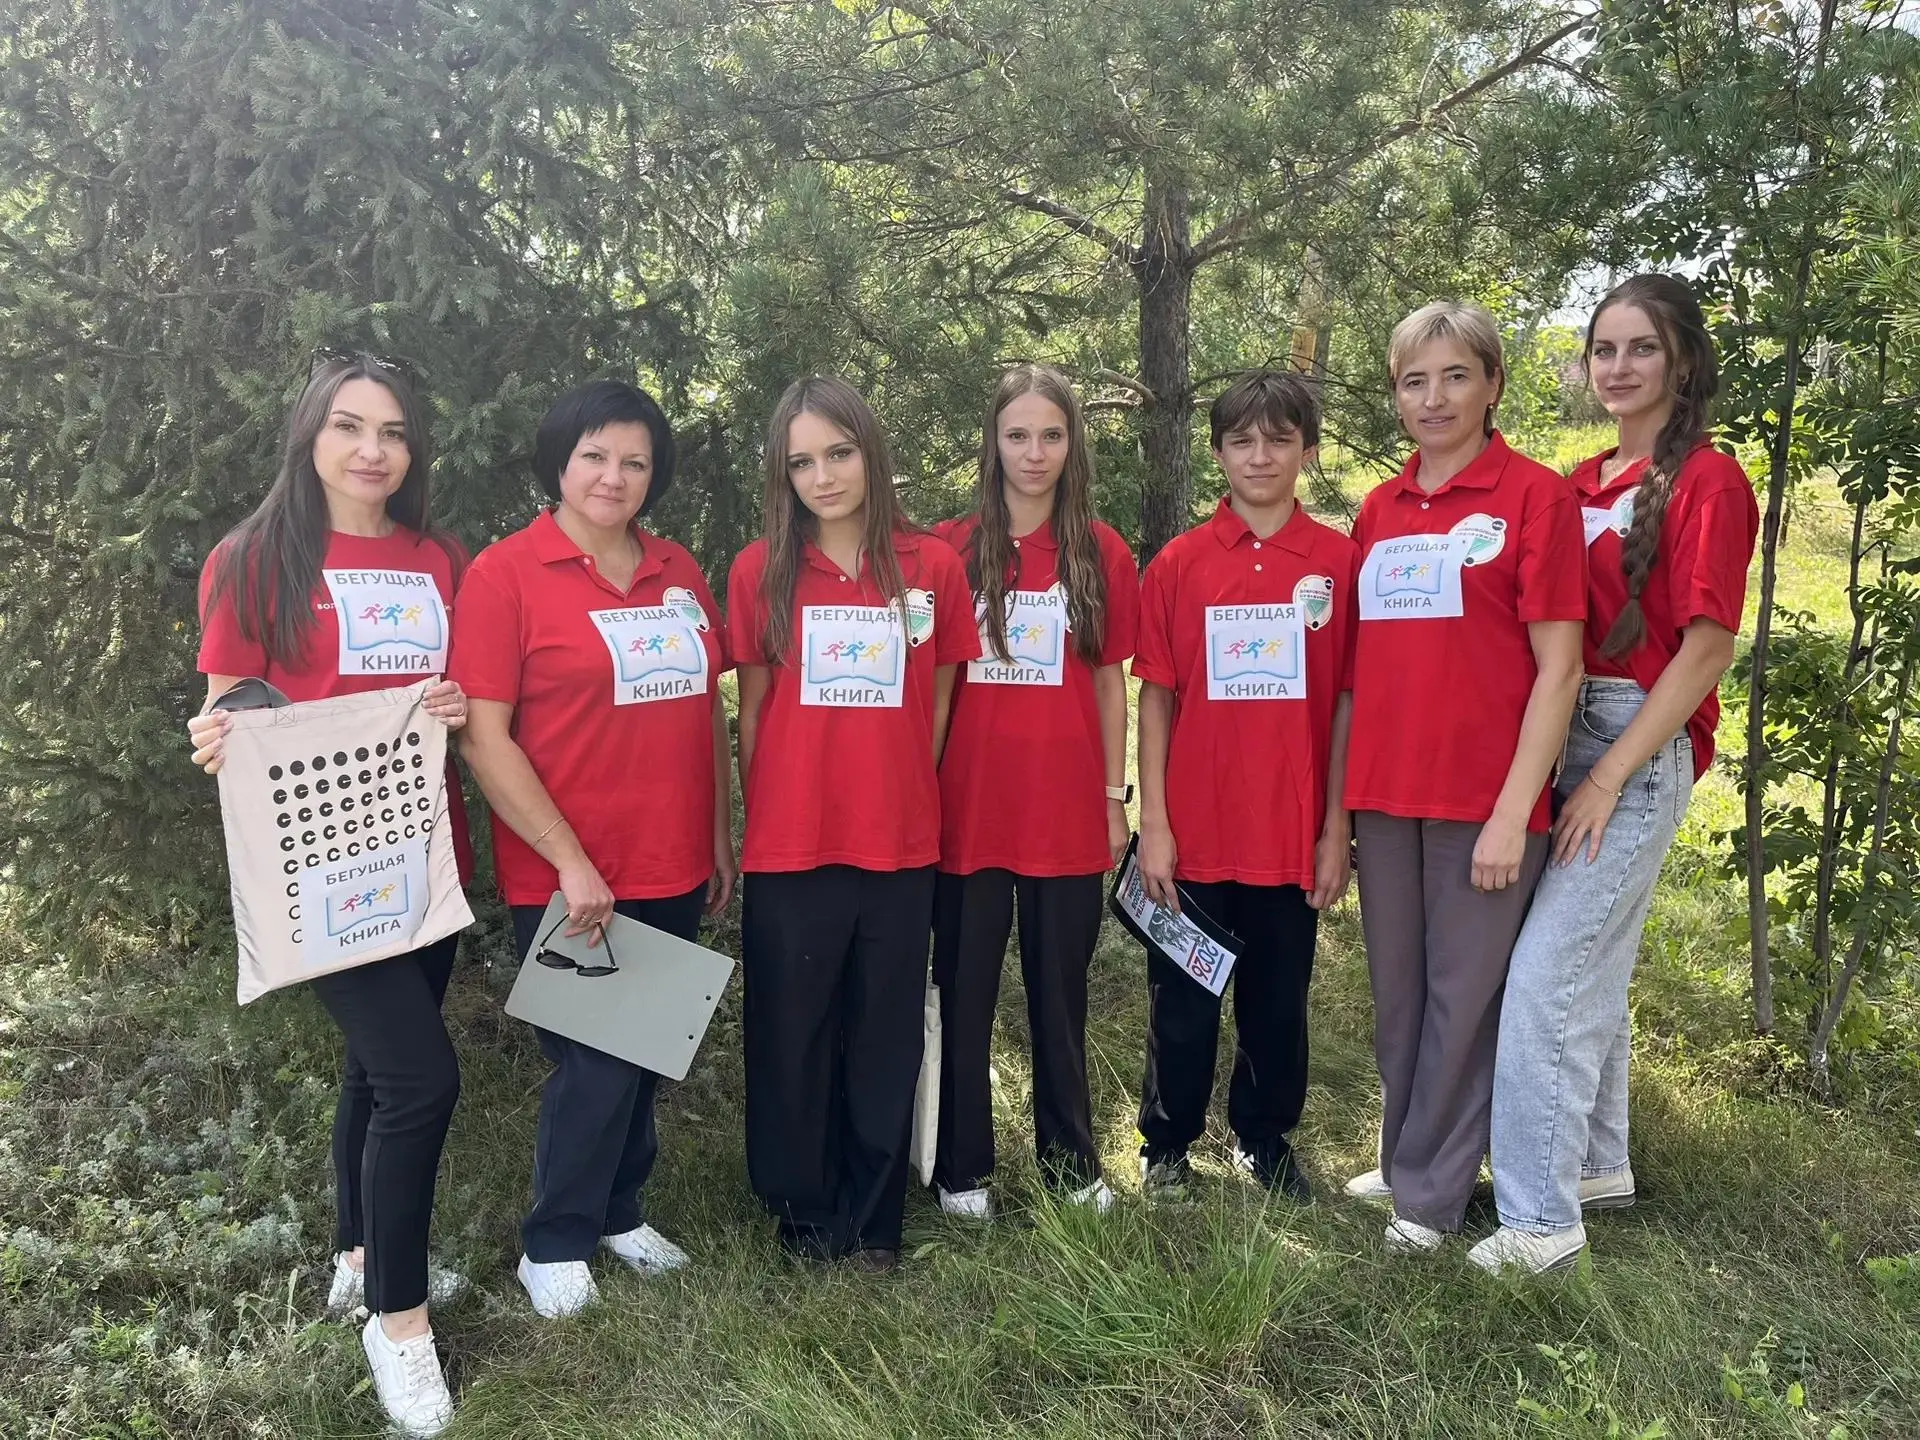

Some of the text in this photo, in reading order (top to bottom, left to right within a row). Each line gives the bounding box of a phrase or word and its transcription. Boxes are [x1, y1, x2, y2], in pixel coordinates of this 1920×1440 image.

[1384, 543, 1449, 555] БЕГУЩАЯ
[335, 573, 428, 588] БЕГУЩАЯ
[977, 594, 1058, 607] БУЩАЯ
[1384, 597, 1433, 609] КНИГА
[600, 608, 680, 624] БЕГУЩАЯ
[811, 609, 897, 624] БЕГУЩАЯ
[1213, 607, 1296, 622] БЕГУЩАЯ
[361, 654, 431, 670] КНИГА
[984, 667, 1046, 682] КНИГА
[633, 678, 693, 699] КНИГА
[819, 688, 886, 703] КНИГА
[1225, 683, 1289, 697] КНИГА
[326, 853, 405, 886] БЕГУЩАЯ
[340, 918, 401, 947] КНИГА
[1191, 940, 1219, 981] 2026
